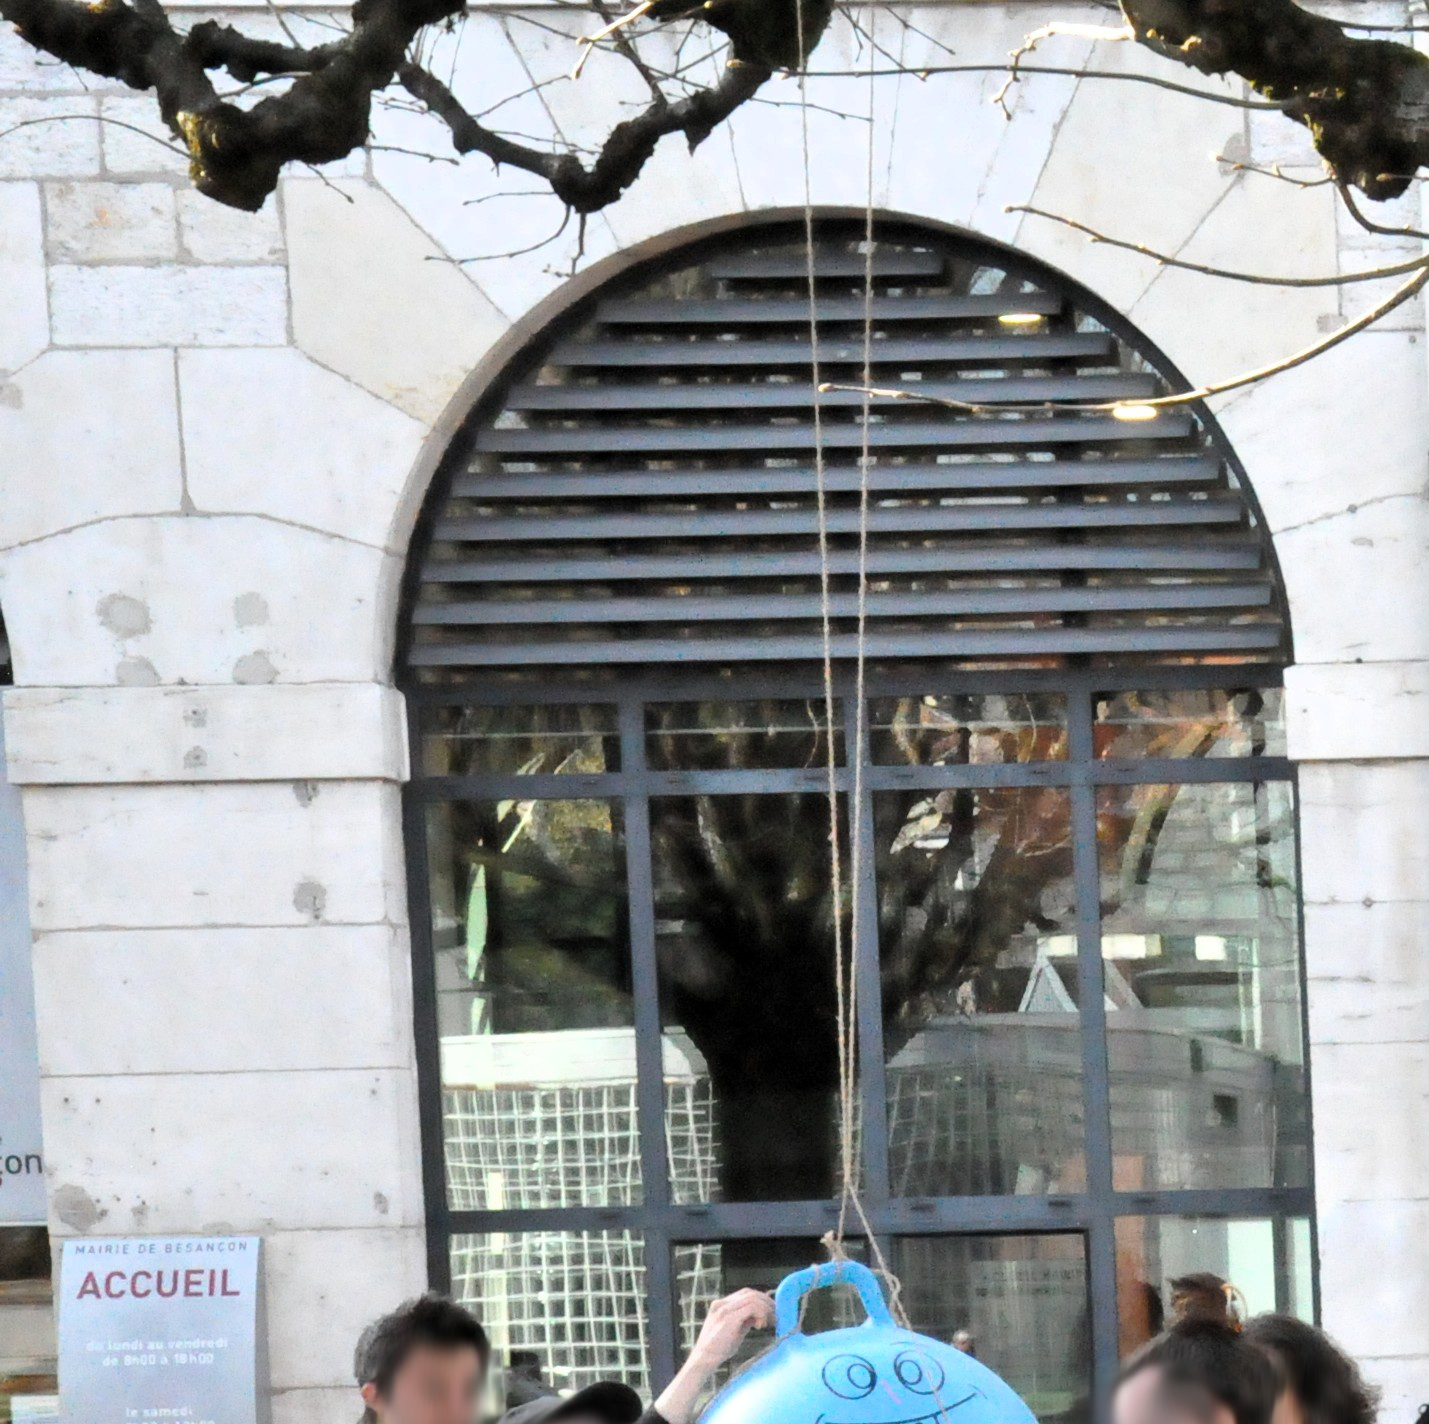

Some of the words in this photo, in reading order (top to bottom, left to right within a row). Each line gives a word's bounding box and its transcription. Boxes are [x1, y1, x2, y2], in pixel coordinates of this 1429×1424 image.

[0, 1154, 43, 1175] on
[75, 1243, 129, 1255] MAIRIE
[137, 1243, 156, 1254] DE
[164, 1241, 248, 1254] BESANÇON
[76, 1269, 240, 1299] ACCUEIL
[168, 1337, 228, 1350] vendredi
[125, 1406, 138, 1418] le
[143, 1405, 193, 1418] samedi
